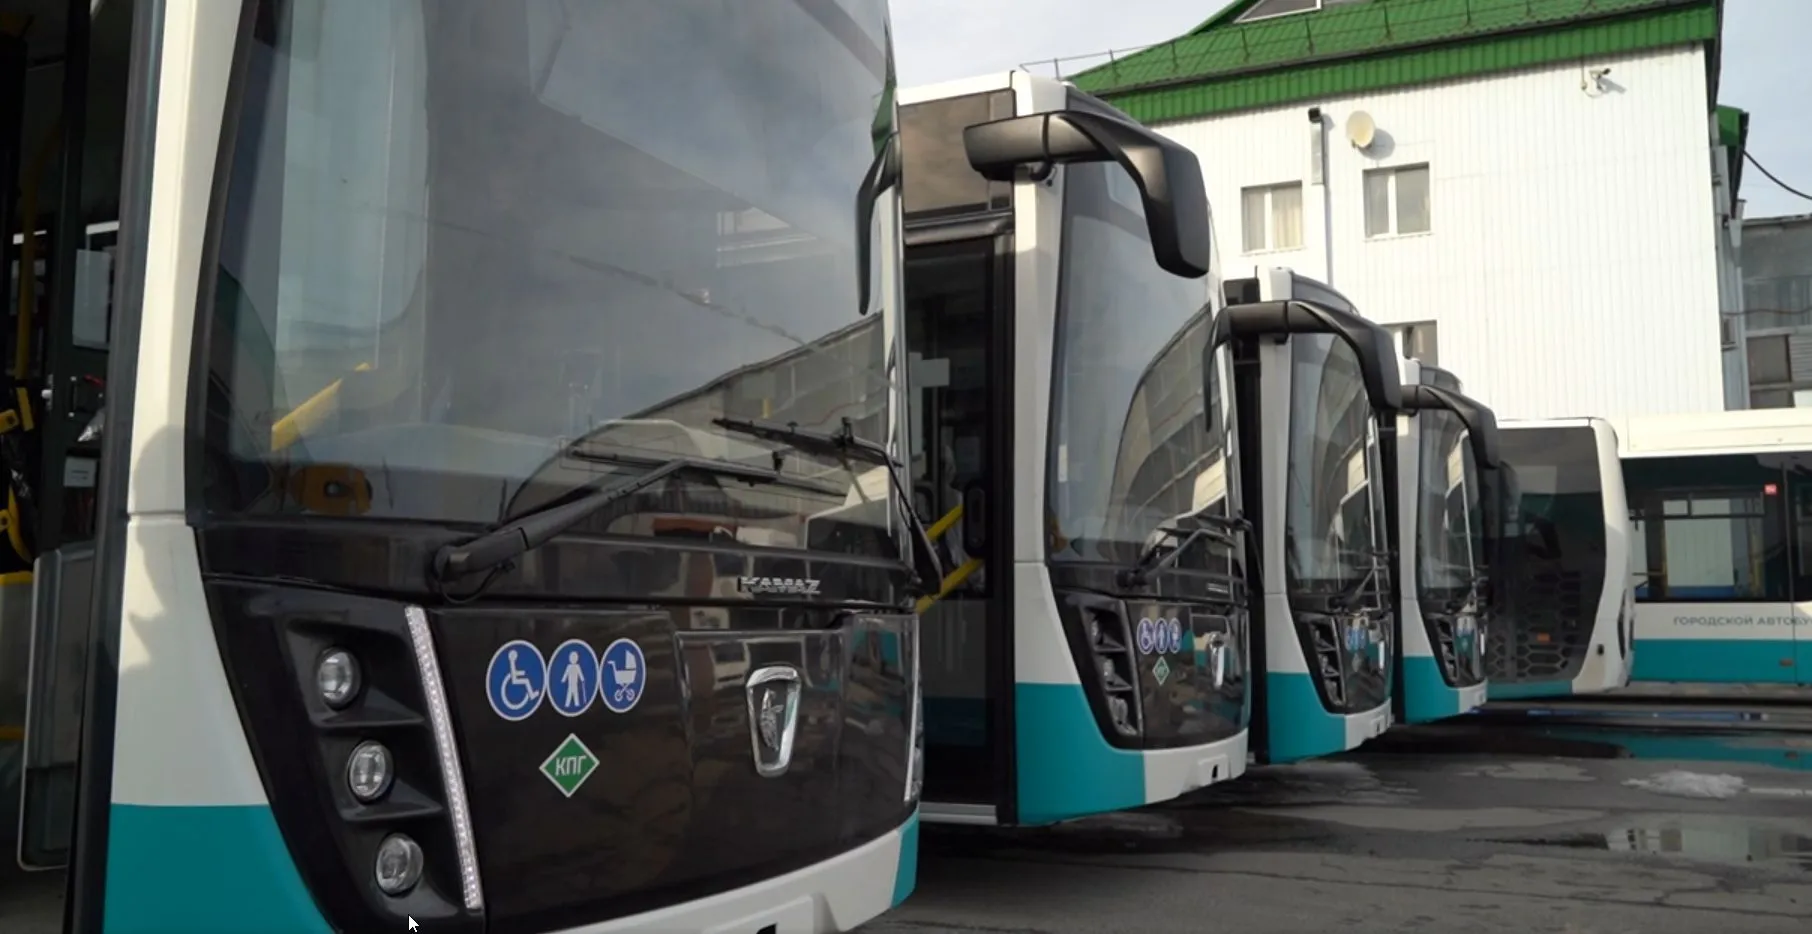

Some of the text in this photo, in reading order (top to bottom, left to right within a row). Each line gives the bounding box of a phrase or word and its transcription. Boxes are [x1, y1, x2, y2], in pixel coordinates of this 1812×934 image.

[738, 576, 821, 595] KAMAZ
[1674, 615, 1812, 627] ГОРОДСКОЙ АВТОБУ
[555, 755, 587, 776] КПГ
